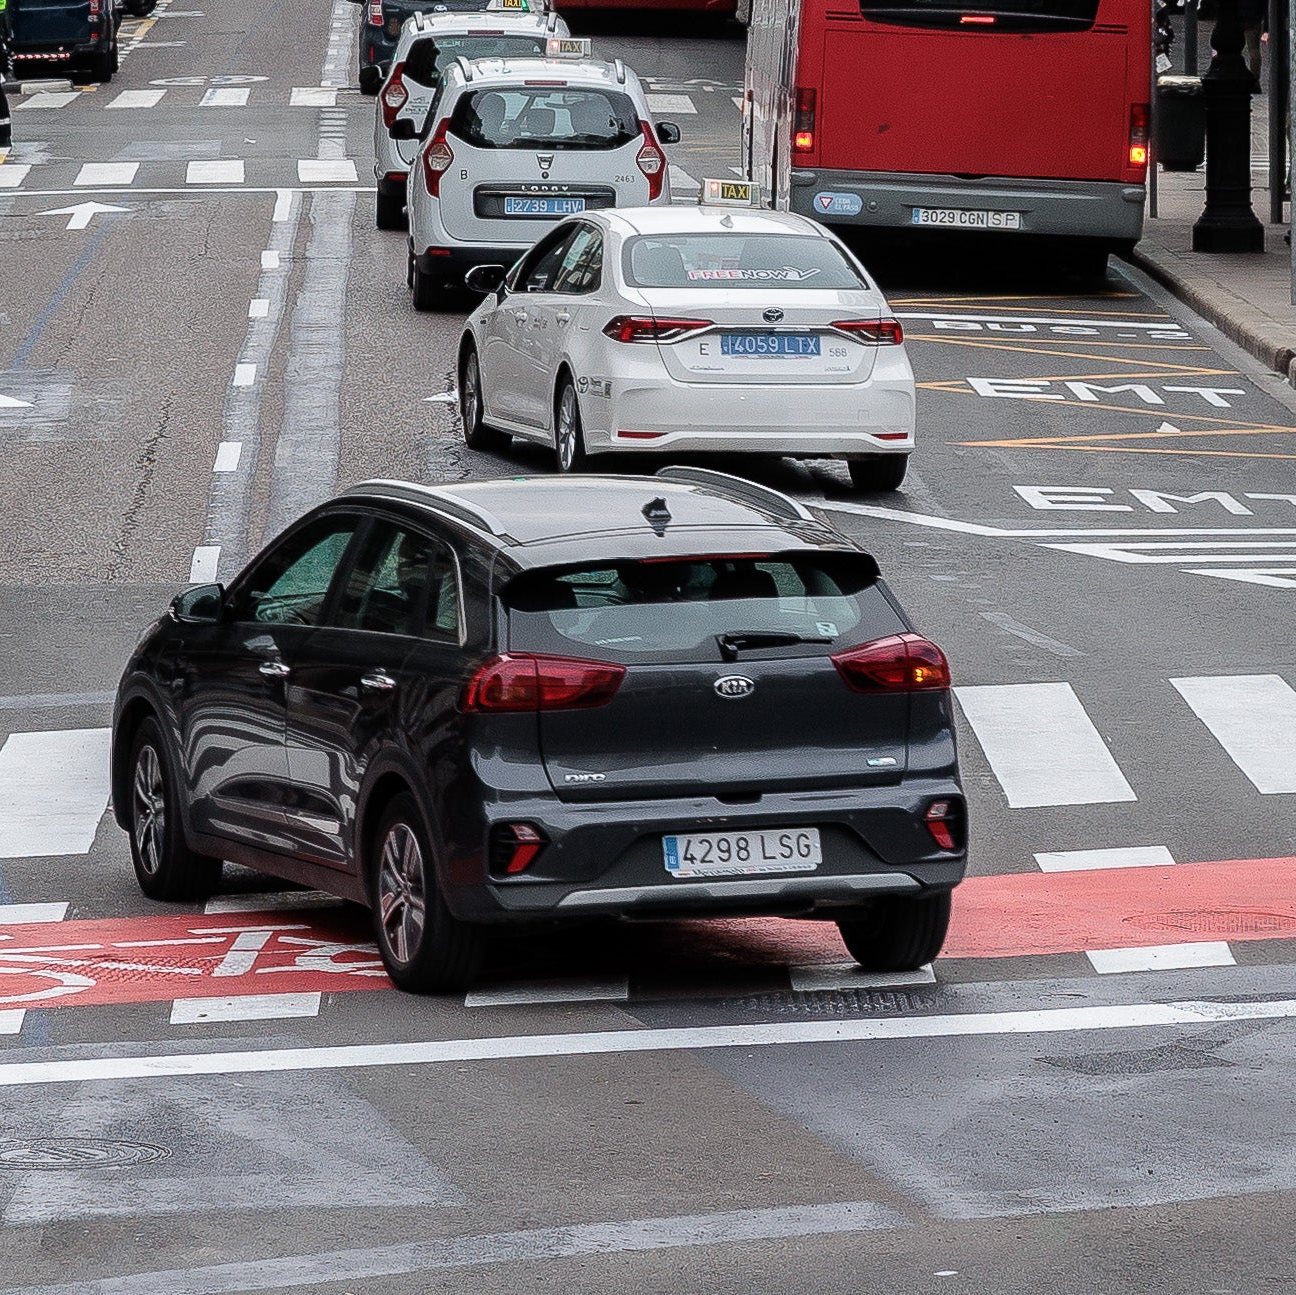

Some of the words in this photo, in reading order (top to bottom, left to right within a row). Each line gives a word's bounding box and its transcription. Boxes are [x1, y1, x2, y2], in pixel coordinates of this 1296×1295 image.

[560, 41, 582, 53] TAXI
[460, 169, 468, 180] B
[614, 175, 635, 183] 2463
[721, 183, 750, 199] TAXI
[515, 200, 548, 212] 2739
[554, 200, 580, 212] LHV
[921, 210, 956, 223] 3029
[959, 211, 985, 225] CGN
[700, 343, 709, 356] E
[734, 336, 779, 352] 4059
[784, 336, 818, 353] LTX
[829, 348, 848, 357] 588
[966, 377, 1246, 408] EMT
[682, 836, 751, 864] 4298
[760, 834, 812, 861] LSG
